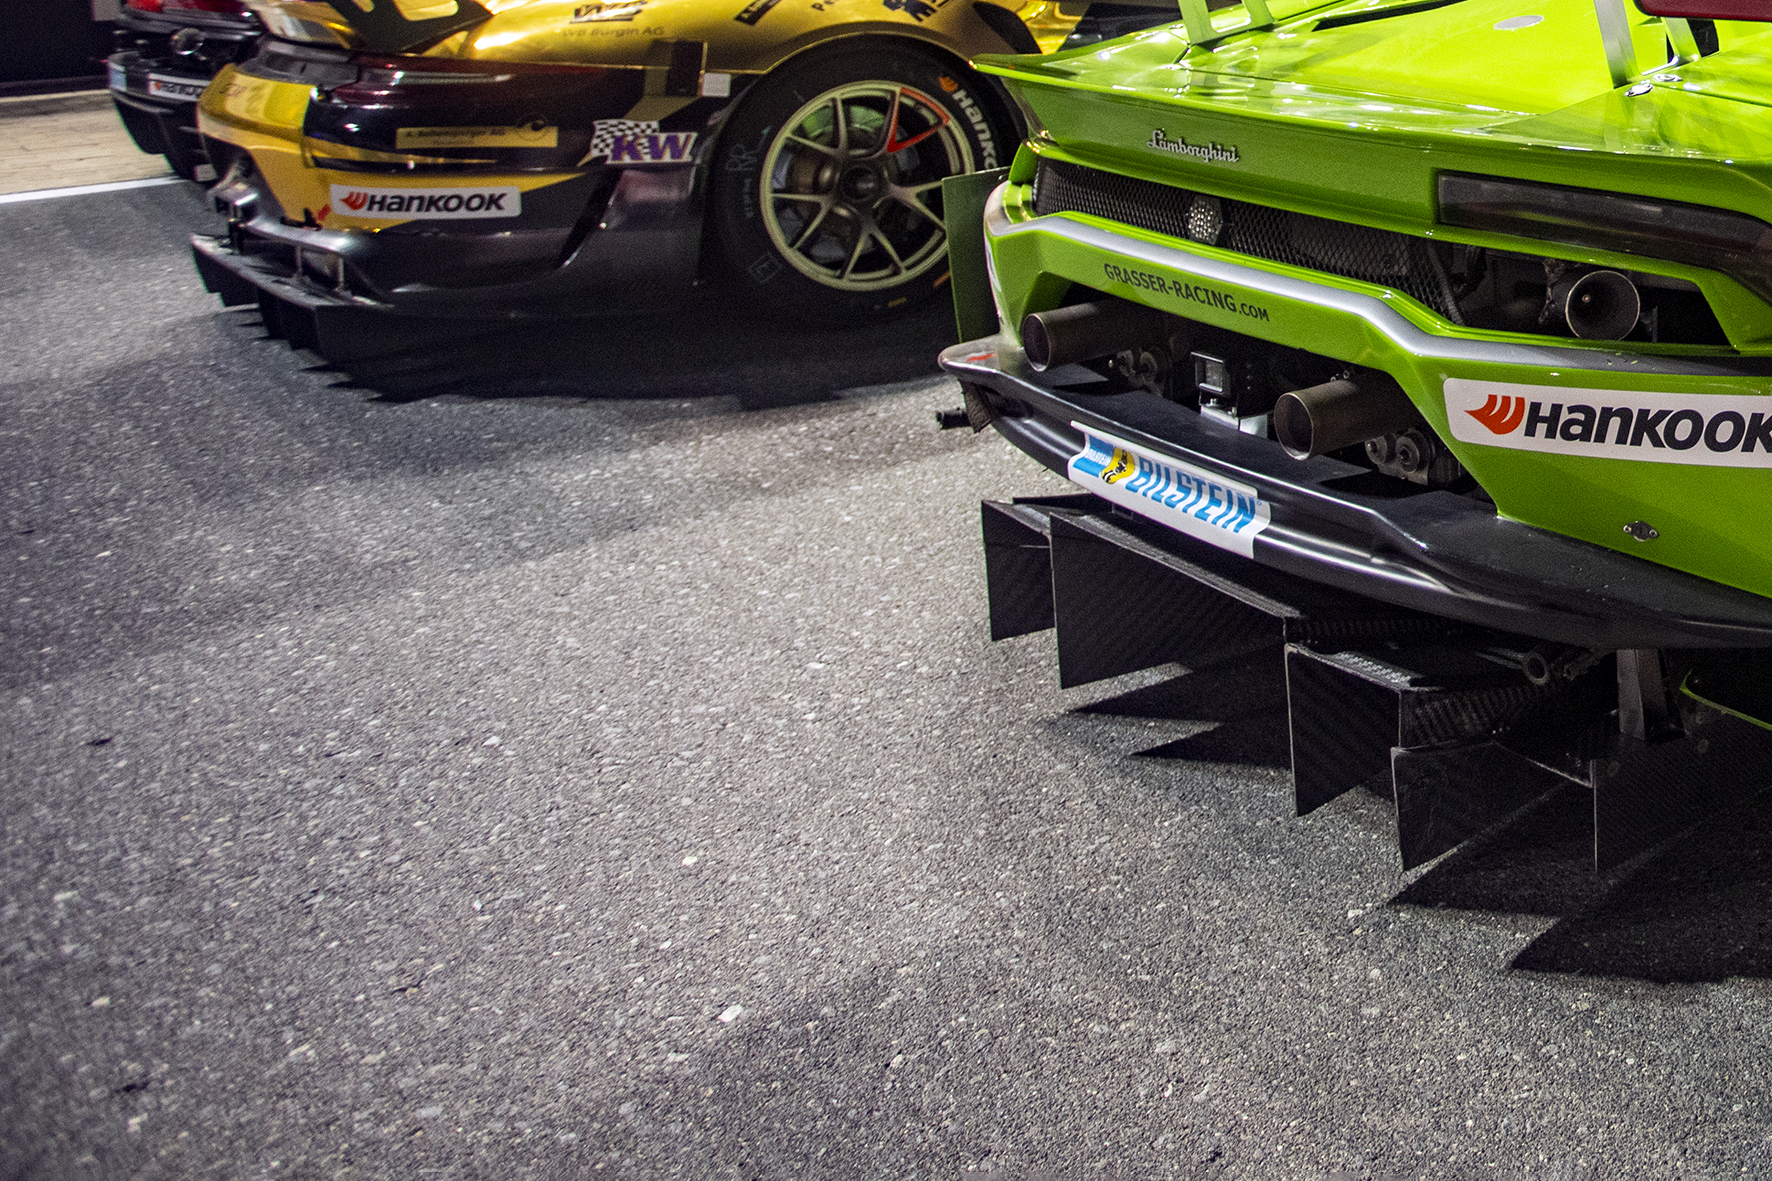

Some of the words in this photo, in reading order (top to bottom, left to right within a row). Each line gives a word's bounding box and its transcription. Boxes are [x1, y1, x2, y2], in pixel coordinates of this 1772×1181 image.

[611, 134, 694, 161] KW
[1146, 128, 1240, 164] Lamborghini
[1103, 262, 1271, 322] GRASSER-RACING.COM
[1125, 454, 1257, 534] BILSTEIN
